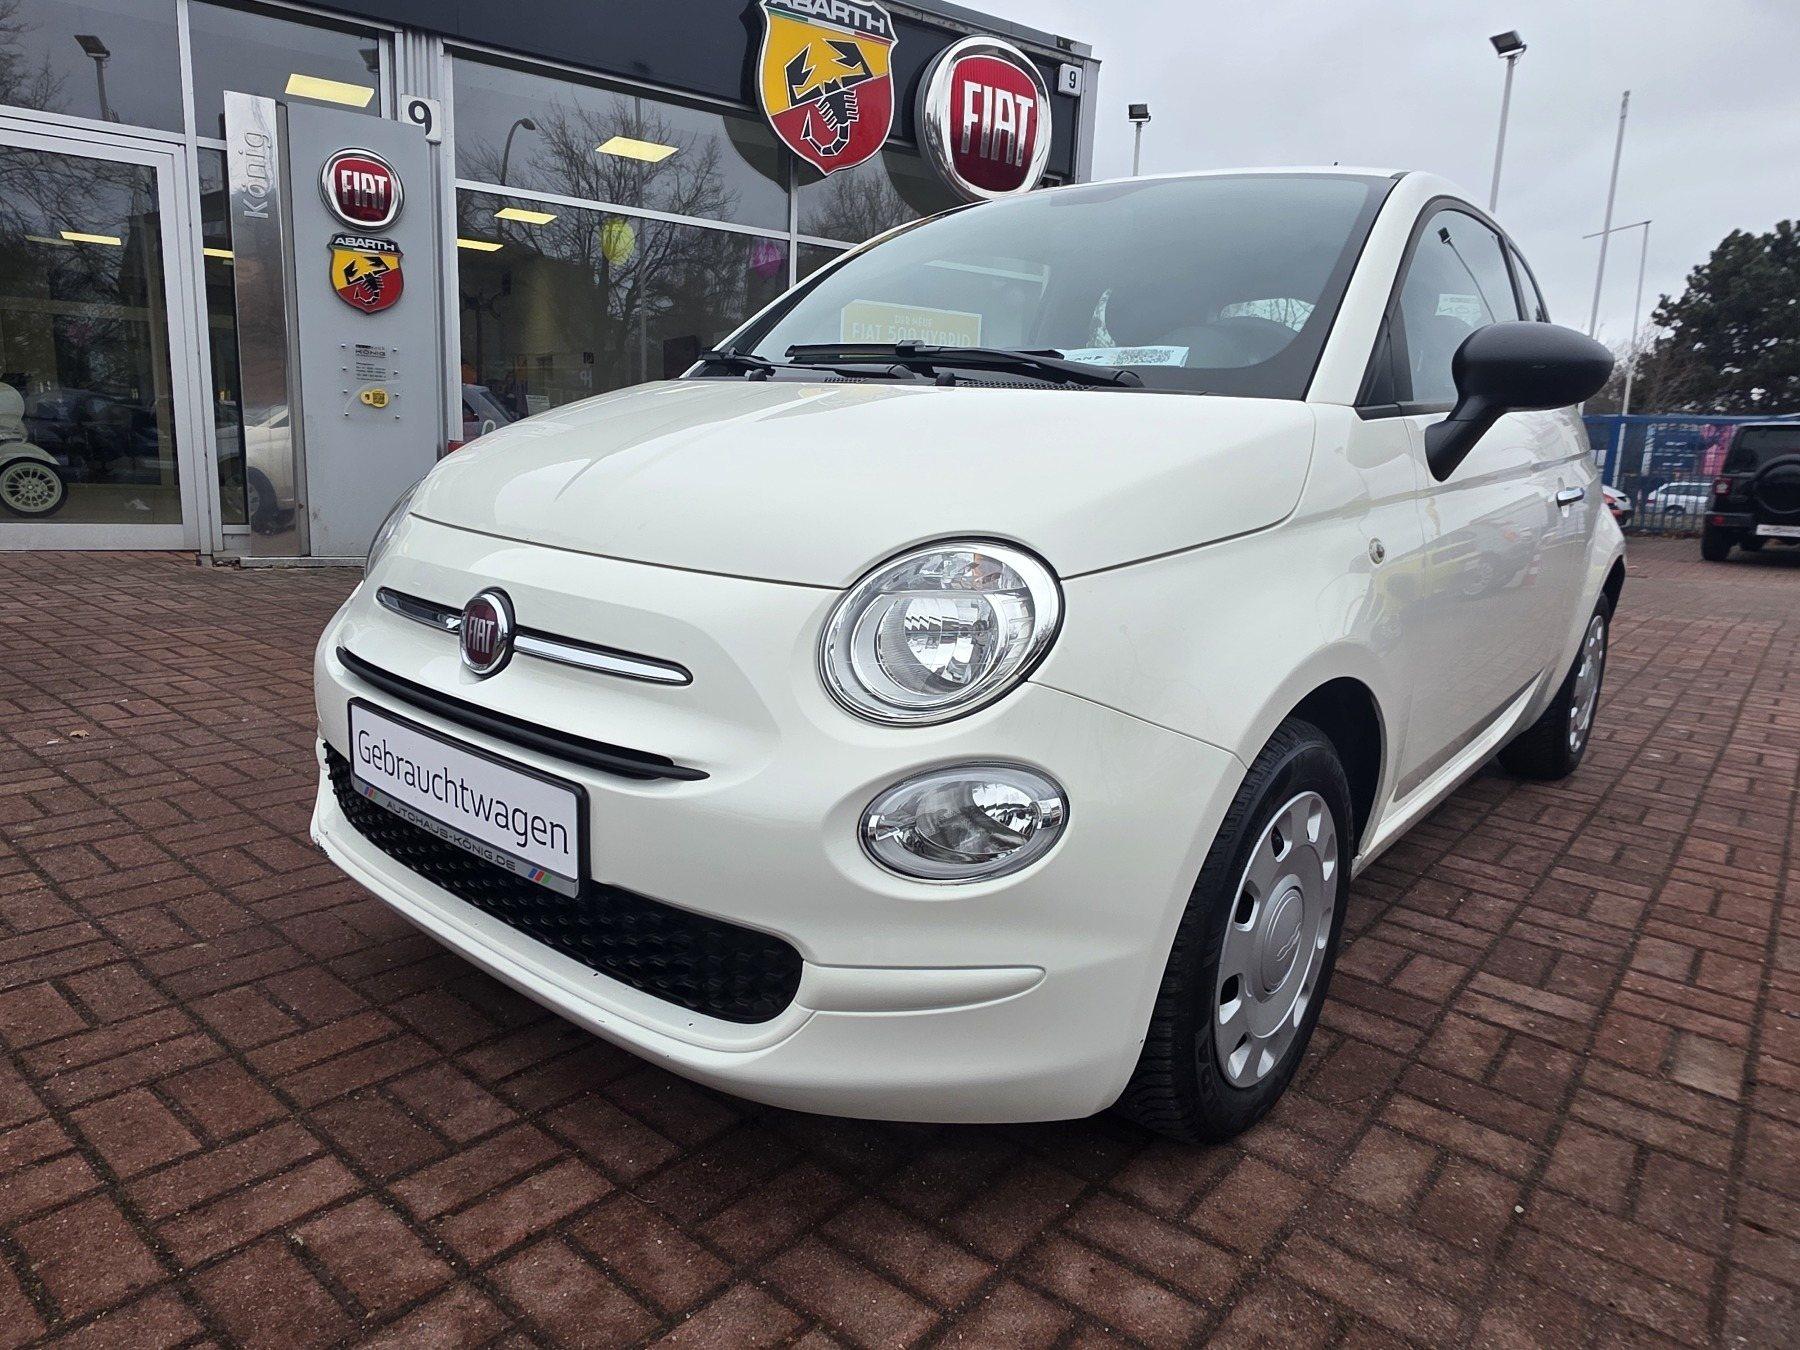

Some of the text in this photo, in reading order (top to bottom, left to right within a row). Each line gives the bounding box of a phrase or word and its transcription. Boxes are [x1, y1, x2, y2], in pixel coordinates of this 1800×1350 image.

[1068, 70, 1077, 89] 9
[408, 100, 432, 136] 9
[961, 80, 1034, 167] FIAT
[238, 132, 271, 219] König
[340, 169, 388, 210] FIAT
[334, 237, 395, 251] ABARTH
[852, 322, 883, 342] FIAT
[888, 325, 917, 342] 500
[467, 616, 495, 655] FIAT
[358, 729, 570, 855] Gebrauchtwagen
[386, 800, 517, 871] AUTOHAUS-KÖNIG.DE
